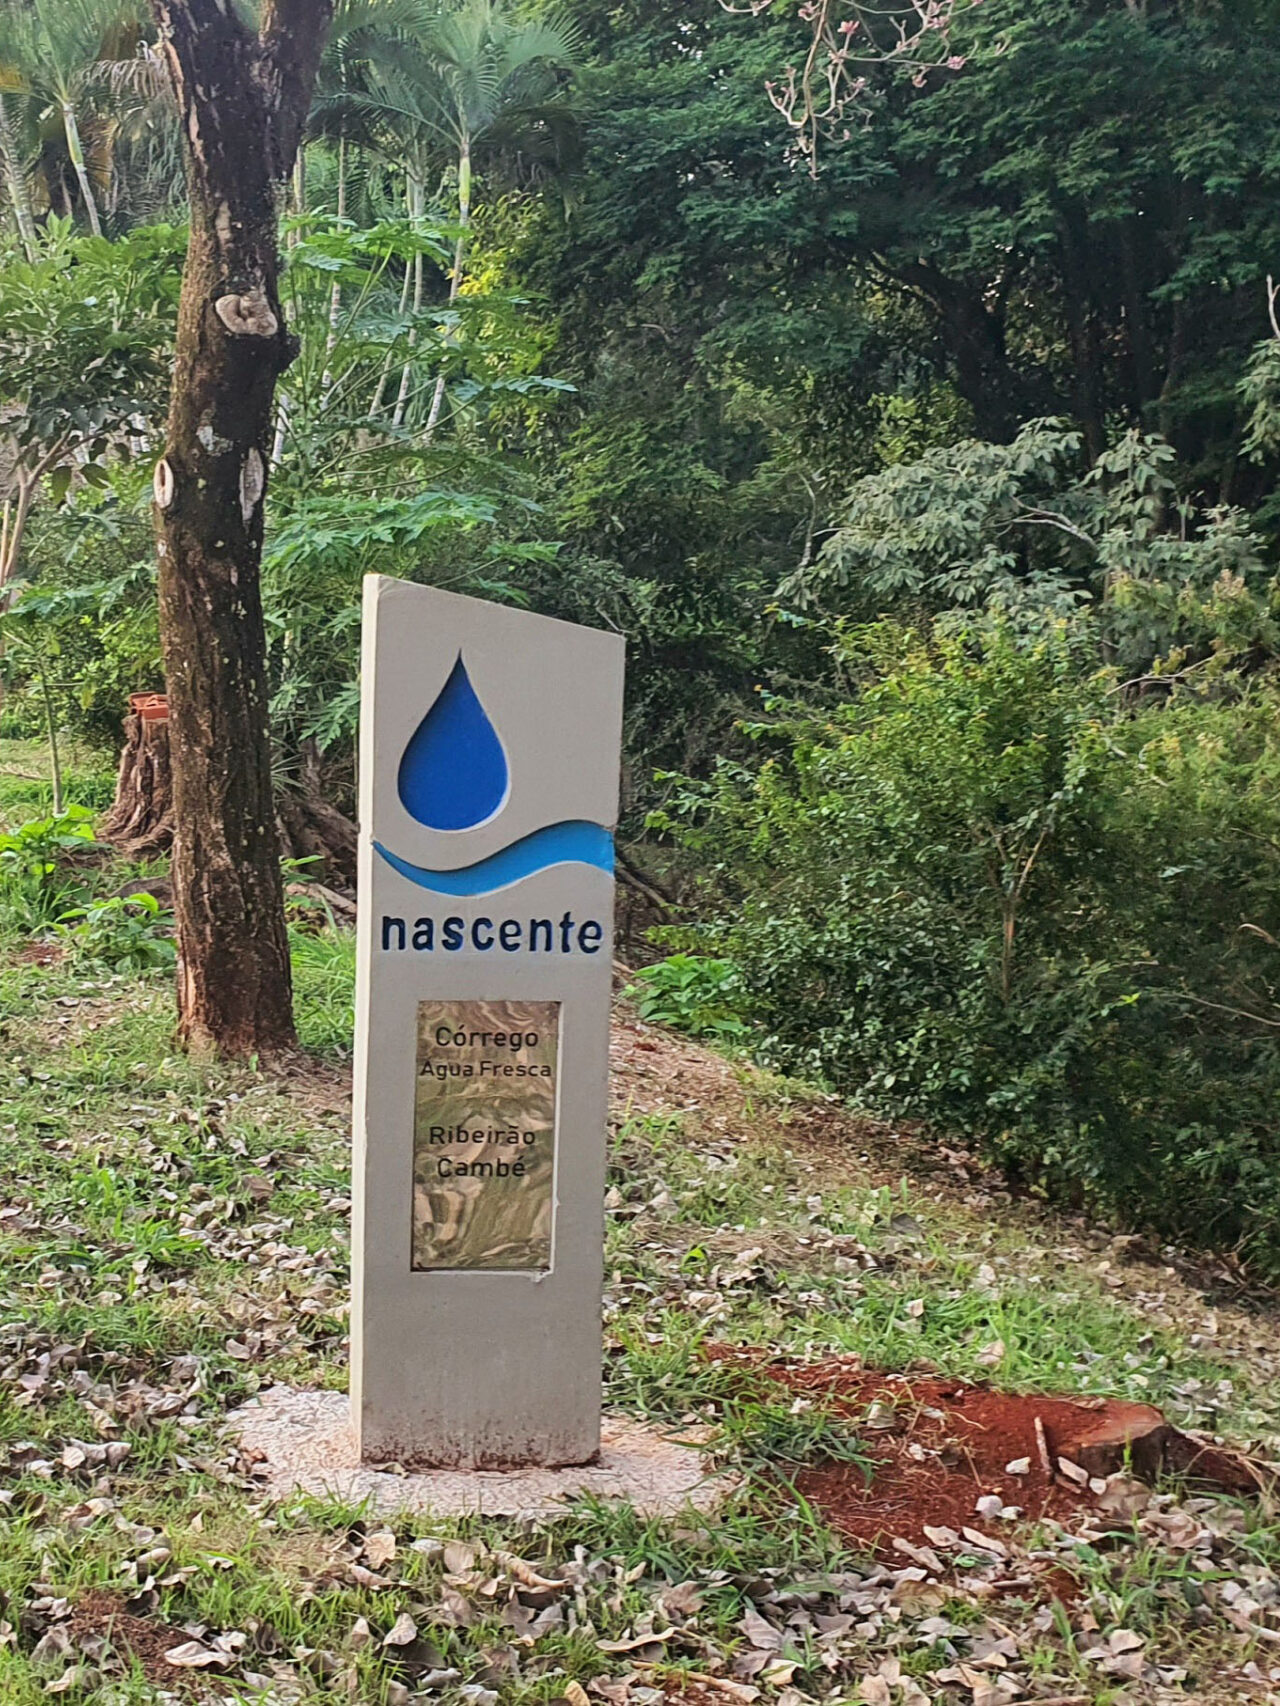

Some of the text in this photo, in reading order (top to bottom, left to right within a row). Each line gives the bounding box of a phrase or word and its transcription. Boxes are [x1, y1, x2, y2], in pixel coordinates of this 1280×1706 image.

[382, 911, 603, 954] nascente
[435, 1024, 539, 1052] Córrego
[480, 1060, 552, 1077] Fresca
[429, 1125, 536, 1145] Ribeirão
[437, 1155, 526, 1178] Cambé
